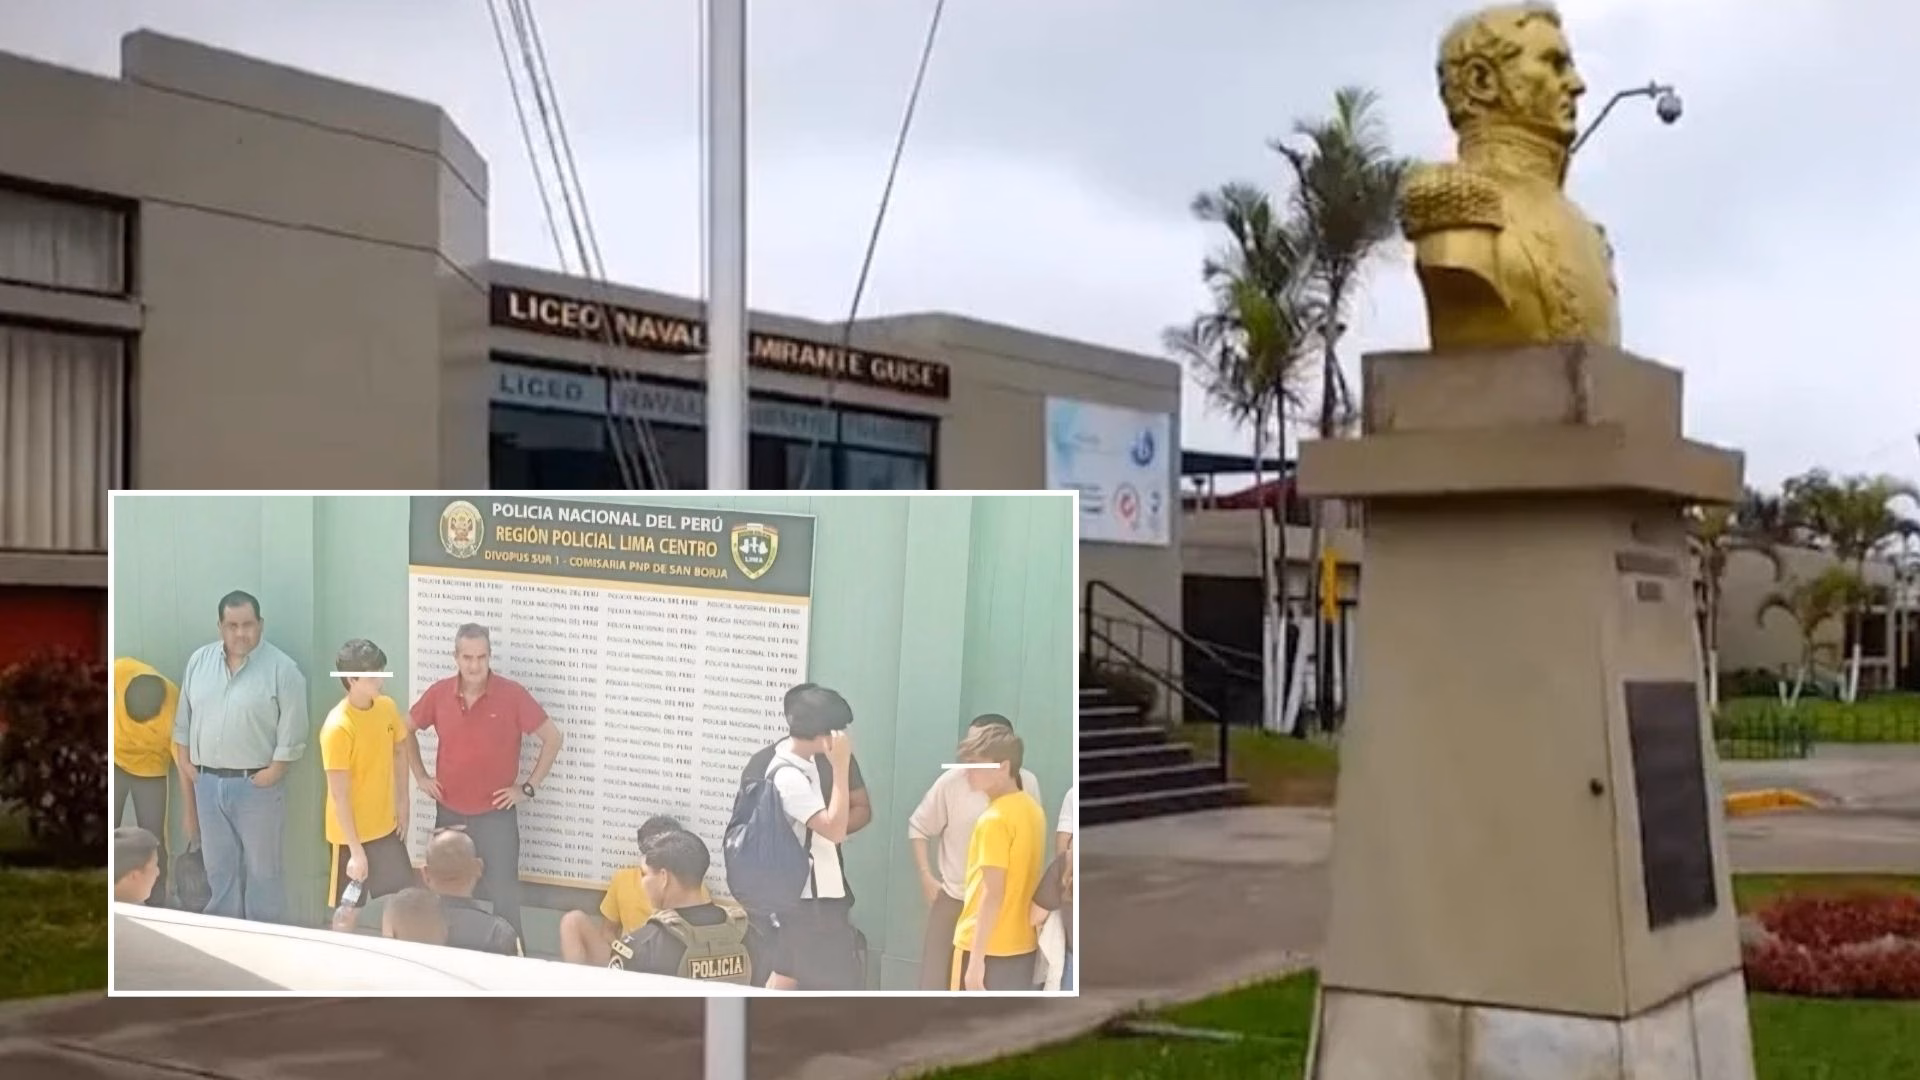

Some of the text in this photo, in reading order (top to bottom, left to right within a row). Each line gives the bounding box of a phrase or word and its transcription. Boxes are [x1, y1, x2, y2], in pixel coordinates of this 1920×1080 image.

[510, 293, 600, 329] LICEO
[615, 312, 702, 347] NAVAL
[753, 335, 863, 375] MIRANTE
[500, 374, 583, 400] LICEO
[492, 503, 723, 533] POLICIA NACIONAL DEL PERÚ
[496, 525, 718, 558] REGIÓN POLICIAL LIMA CENTRO
[484, 550, 530, 563] DIVOPUS
[531, 552, 551, 564] SUR
[569, 556, 626, 570] COMISARIA
[629, 562, 650, 573] PNP
[653, 563, 666, 574] DE
[669, 564, 691, 576] SAN
[694, 567, 728, 580] BORJA
[692, 956, 743, 979] POLICIA
